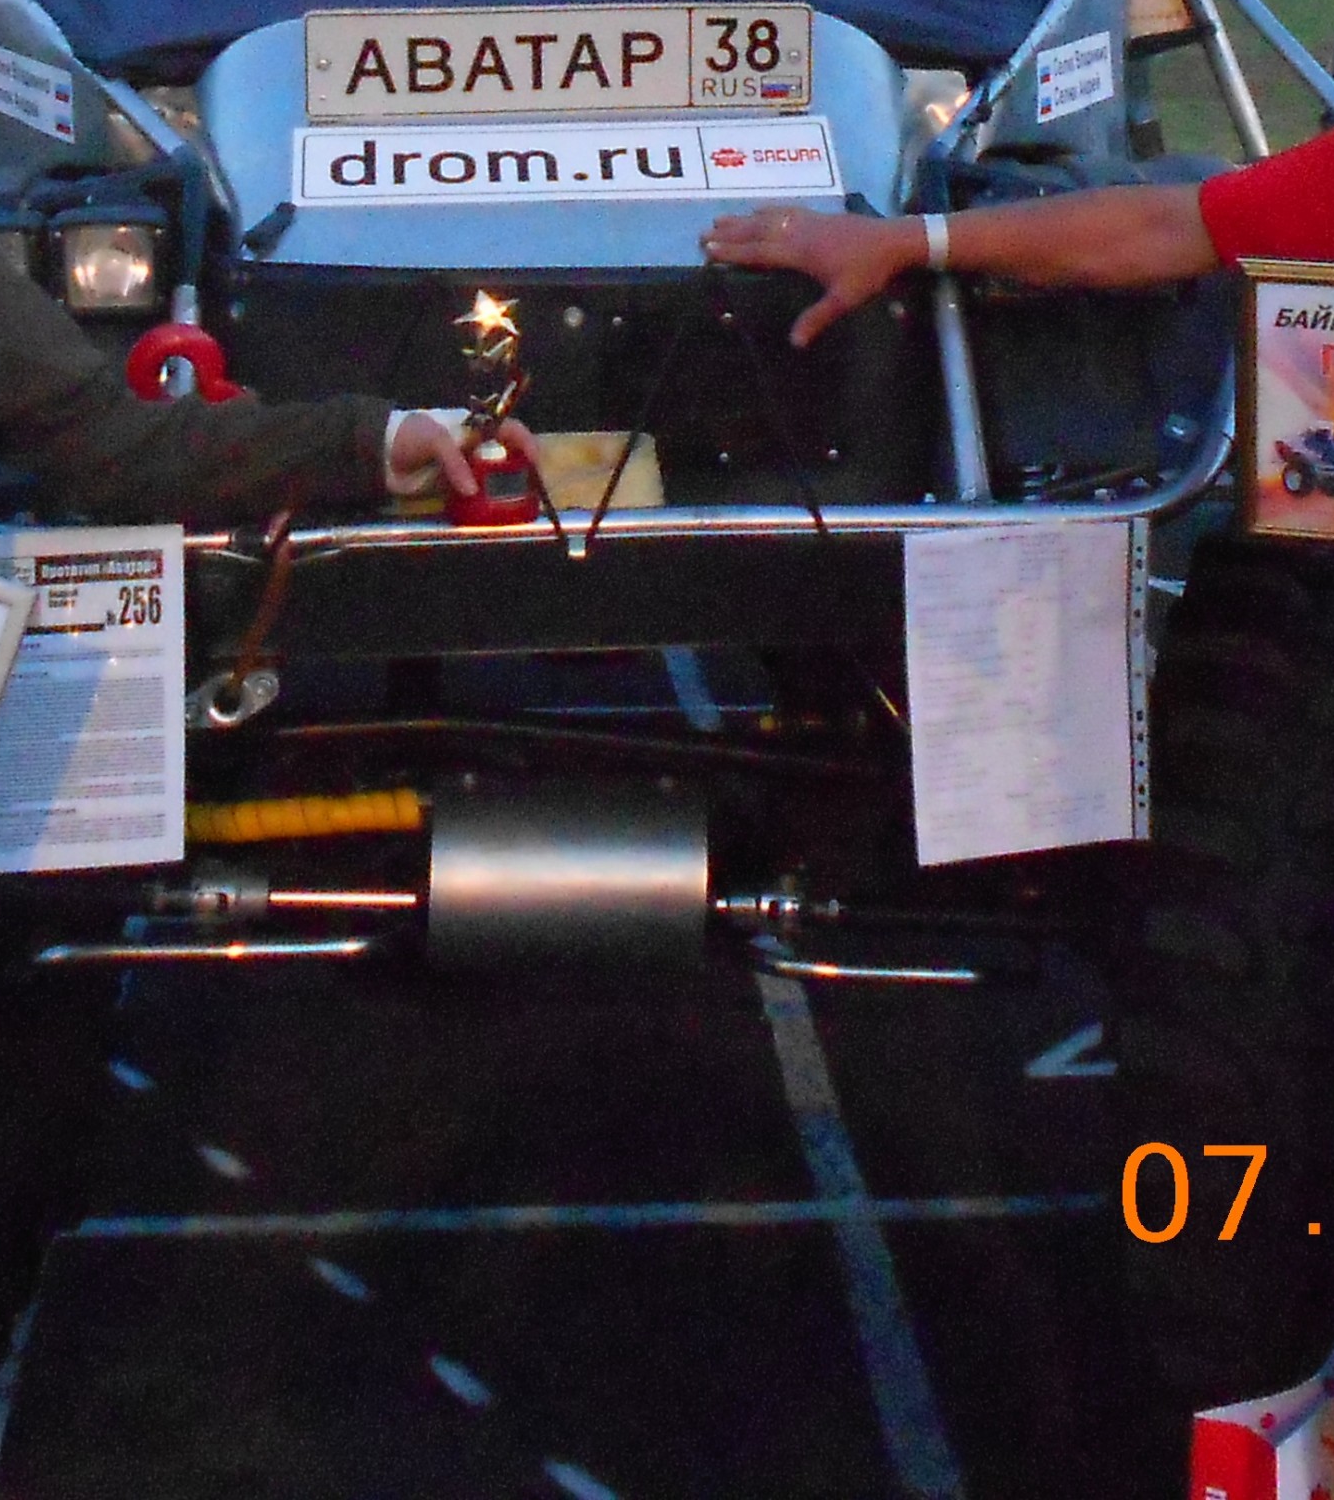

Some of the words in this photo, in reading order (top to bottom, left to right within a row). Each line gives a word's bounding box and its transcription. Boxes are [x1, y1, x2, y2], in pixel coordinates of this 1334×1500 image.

[345, 31, 665, 95] АВАТАР
[704, 17, 781, 74] 38
[702, 76, 757, 98] RUS
[329, 140, 684, 187] drom.ru
[118, 584, 162, 625] 256
